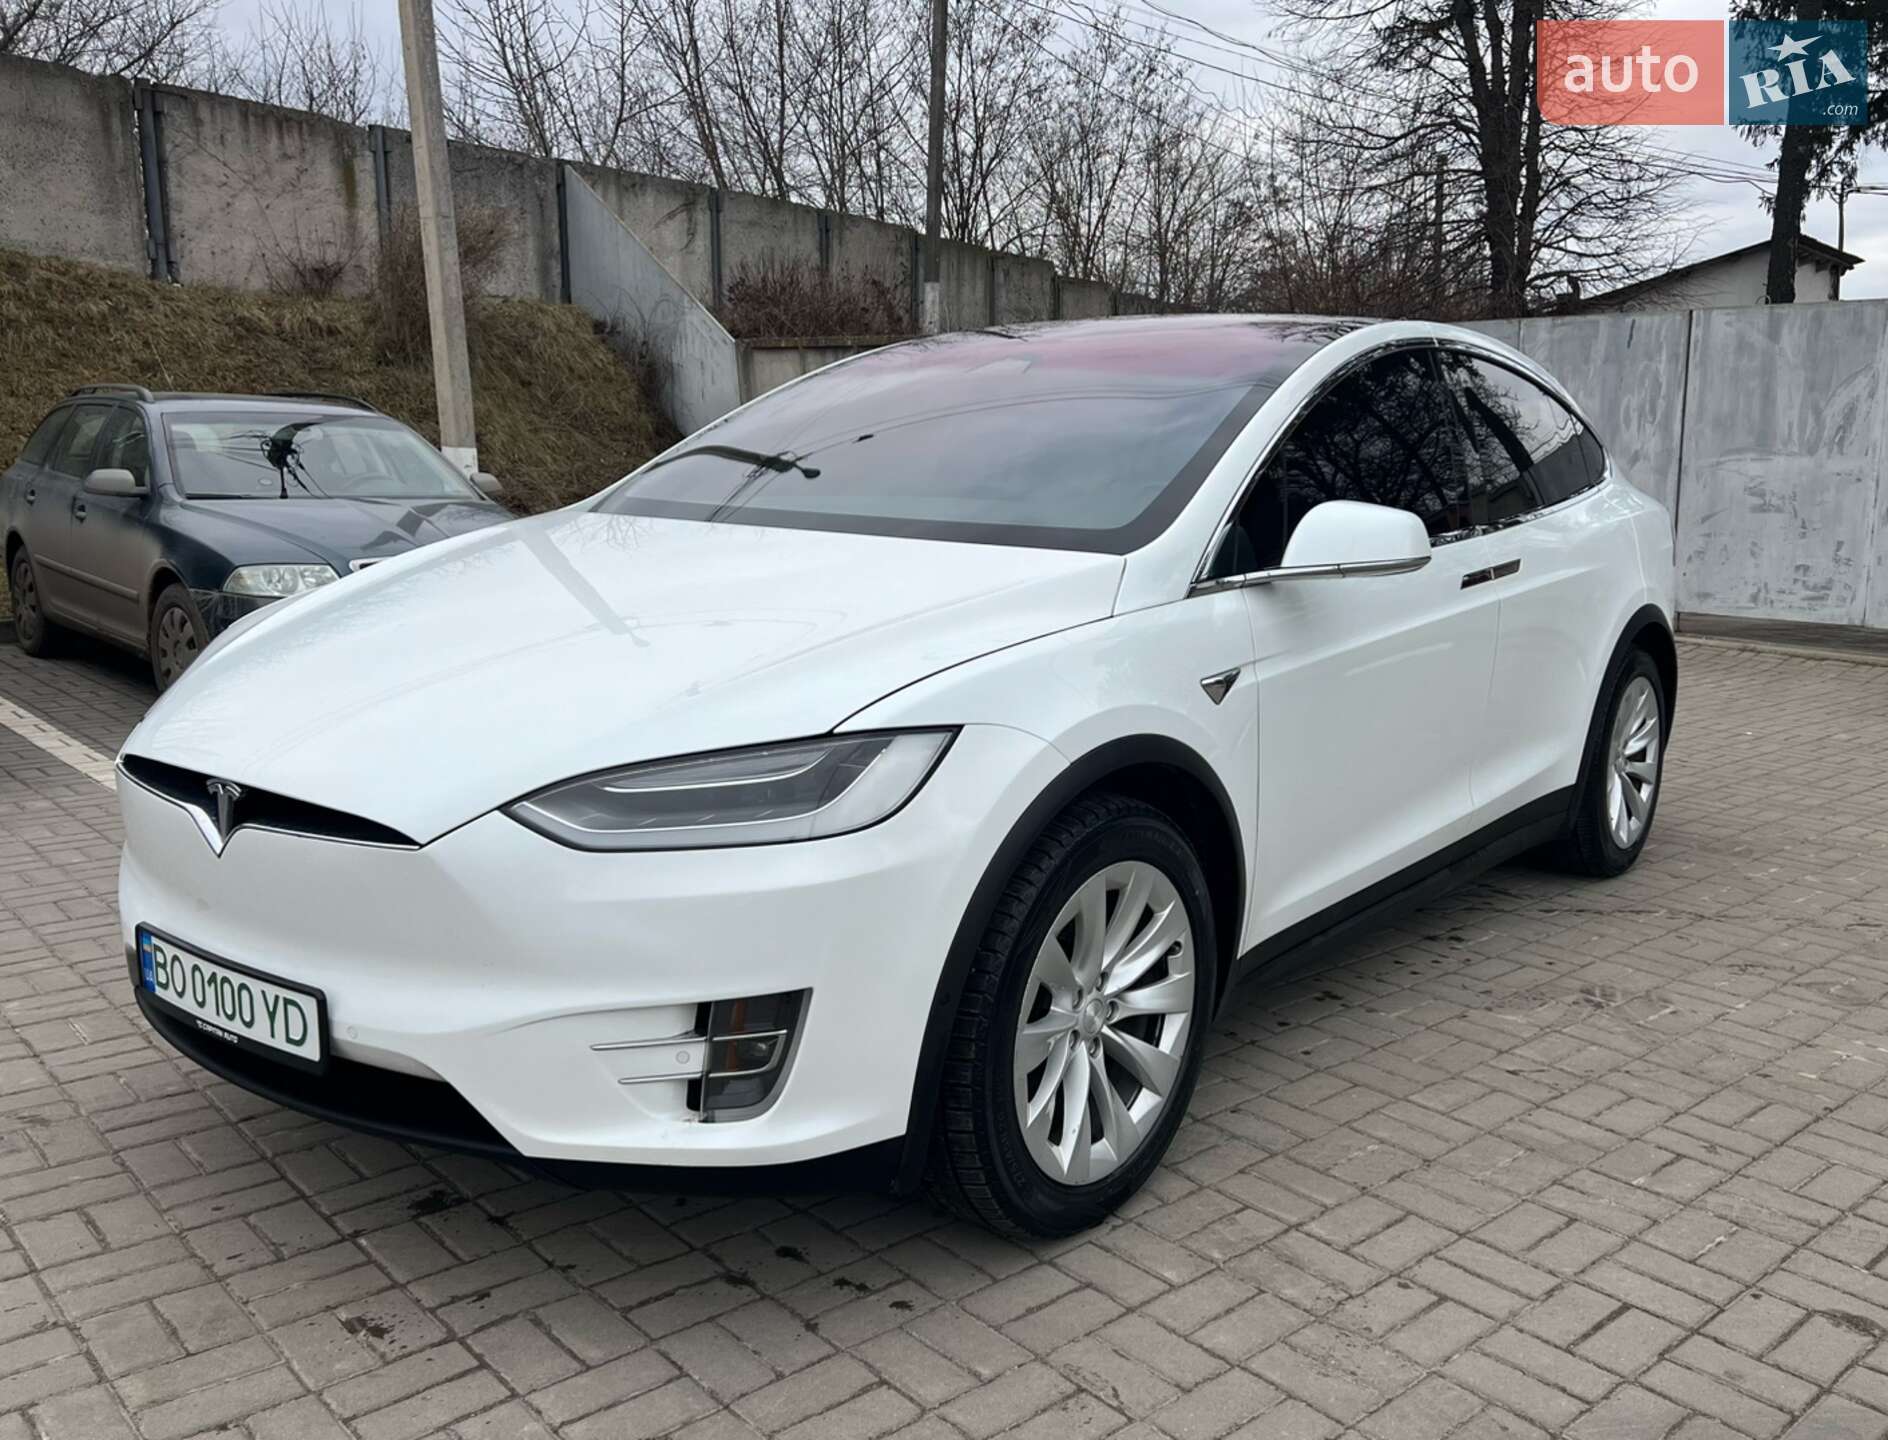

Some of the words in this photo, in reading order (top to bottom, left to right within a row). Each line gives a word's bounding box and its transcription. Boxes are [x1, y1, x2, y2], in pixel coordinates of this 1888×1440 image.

[153, 943, 186, 999] BO
[191, 963, 255, 1029] 0100
[261, 989, 308, 1047] YD
